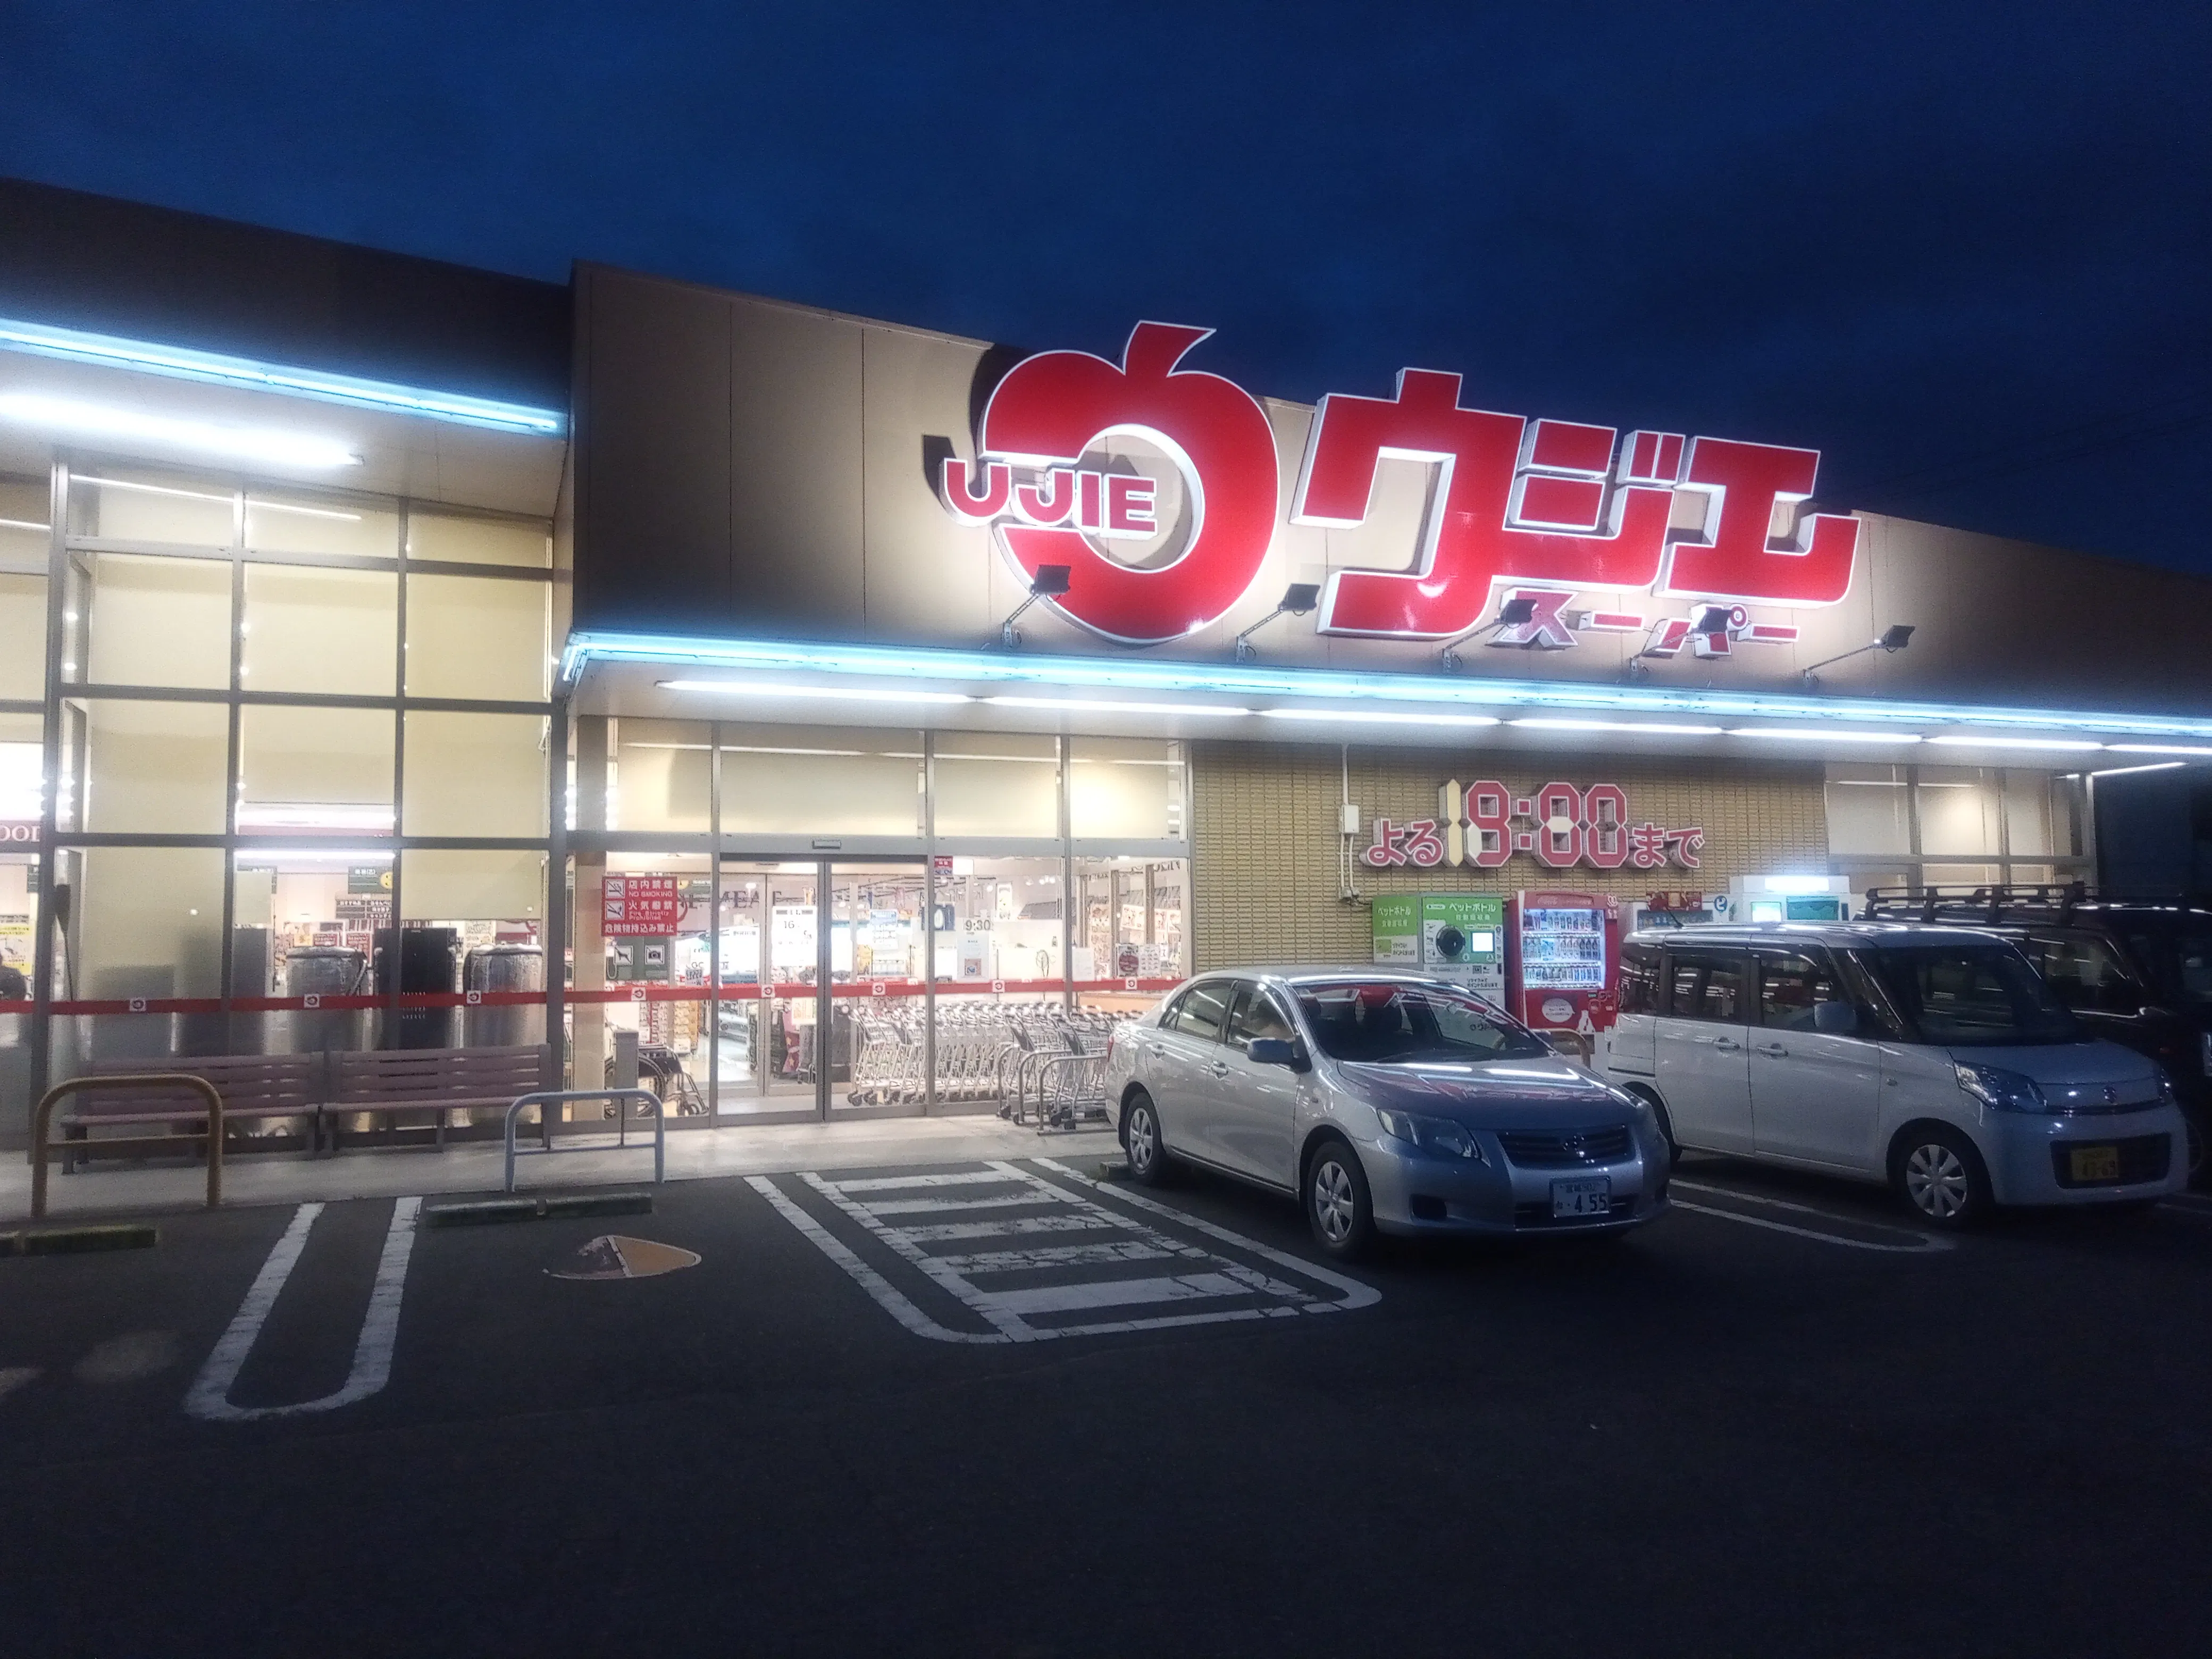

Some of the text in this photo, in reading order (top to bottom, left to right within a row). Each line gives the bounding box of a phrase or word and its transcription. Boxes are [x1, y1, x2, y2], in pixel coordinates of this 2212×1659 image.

[944, 458, 1158, 534] UJIE
[1291, 367, 1861, 636] ウジエ
[1449, 903, 1496, 912] ペットボトル
